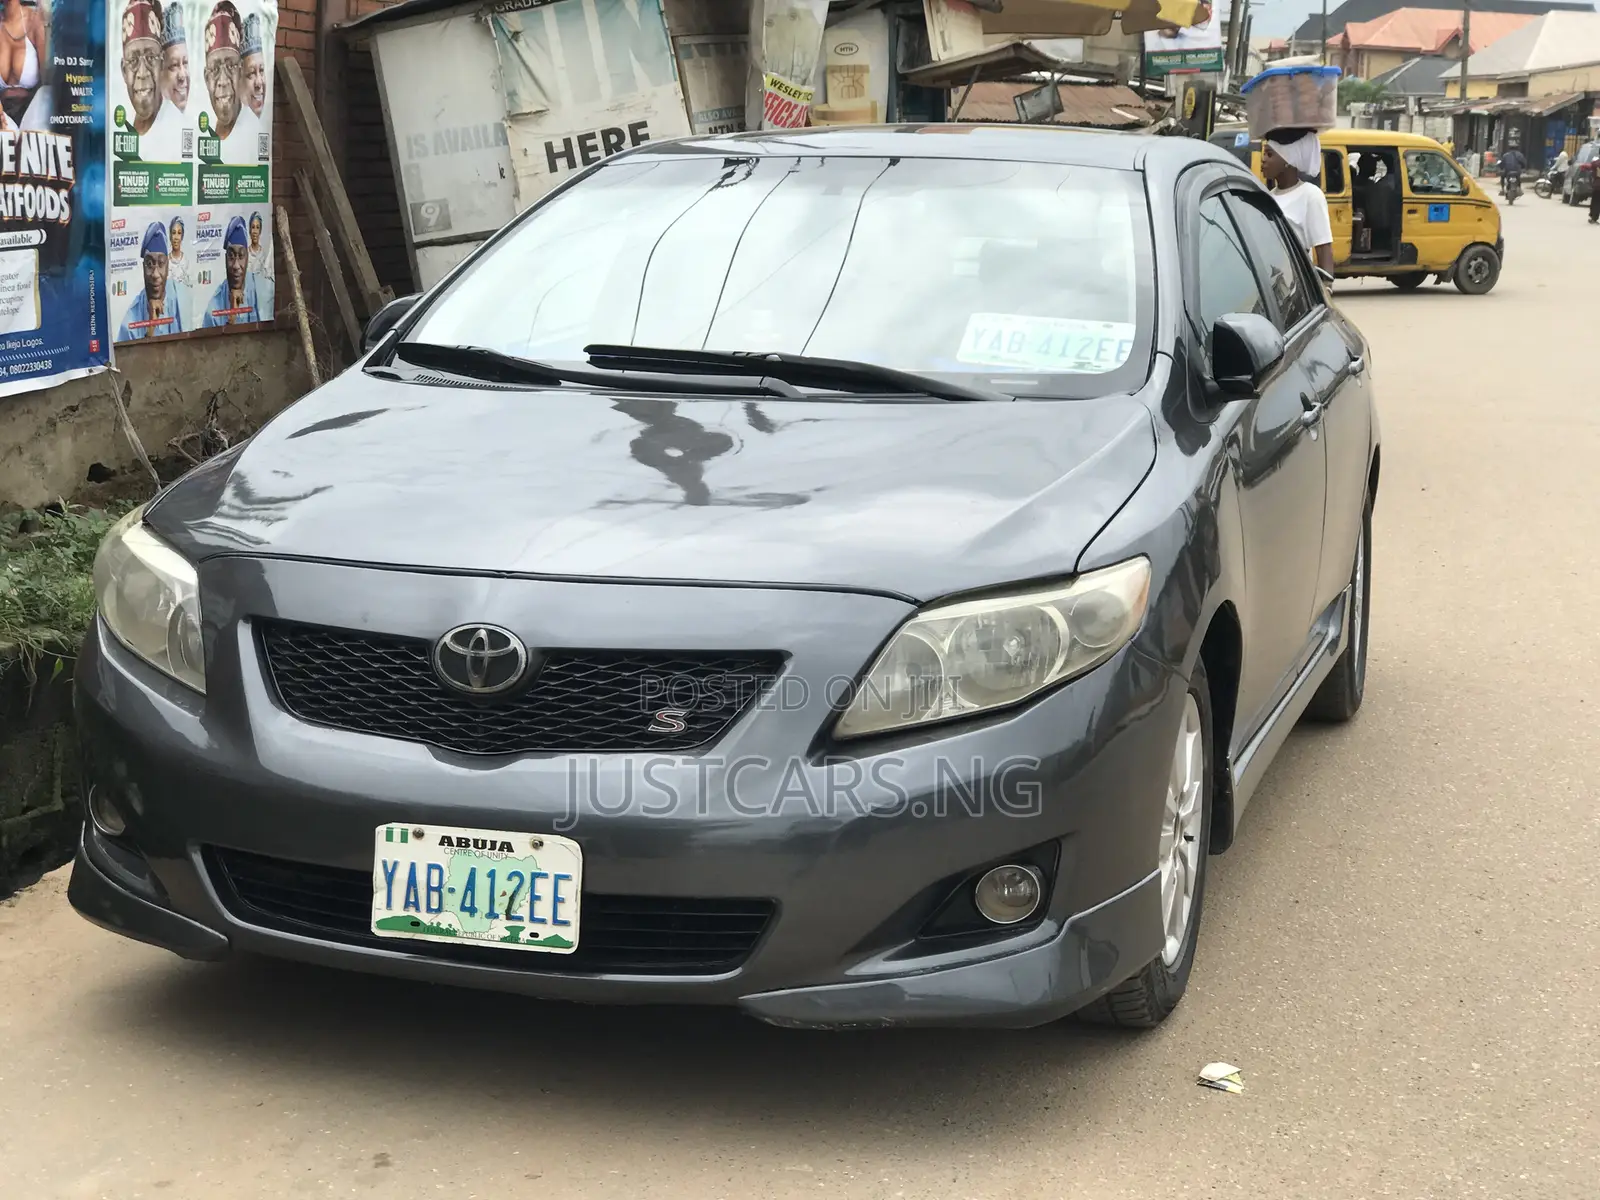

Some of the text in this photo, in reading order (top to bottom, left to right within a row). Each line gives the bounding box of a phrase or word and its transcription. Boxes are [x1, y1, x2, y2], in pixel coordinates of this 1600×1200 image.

[66, 56, 78, 66] DJ
[770, 77, 803, 100] WESLEY
[405, 133, 429, 160] IS
[19, 131, 73, 181] NITE
[118, 176, 150, 187] TINUBU
[158, 178, 190, 187] SHETTIMA
[202, 178, 230, 188] TINUBU
[237, 179, 265, 188] SHETTIMA
[420, 202, 441, 227] 9
[111, 219, 125, 229] VOTE
[0, 233, 33, 245] available
[196, 229, 222, 239] HAMZAT
[110, 236, 139, 247] HAMZAT
[9, 359, 53, 375] 08022330438
[648, 709, 688, 733] S
[438, 835, 515, 853] ABUJA
[443, 847, 509, 860] CENTRE OF UNITY
